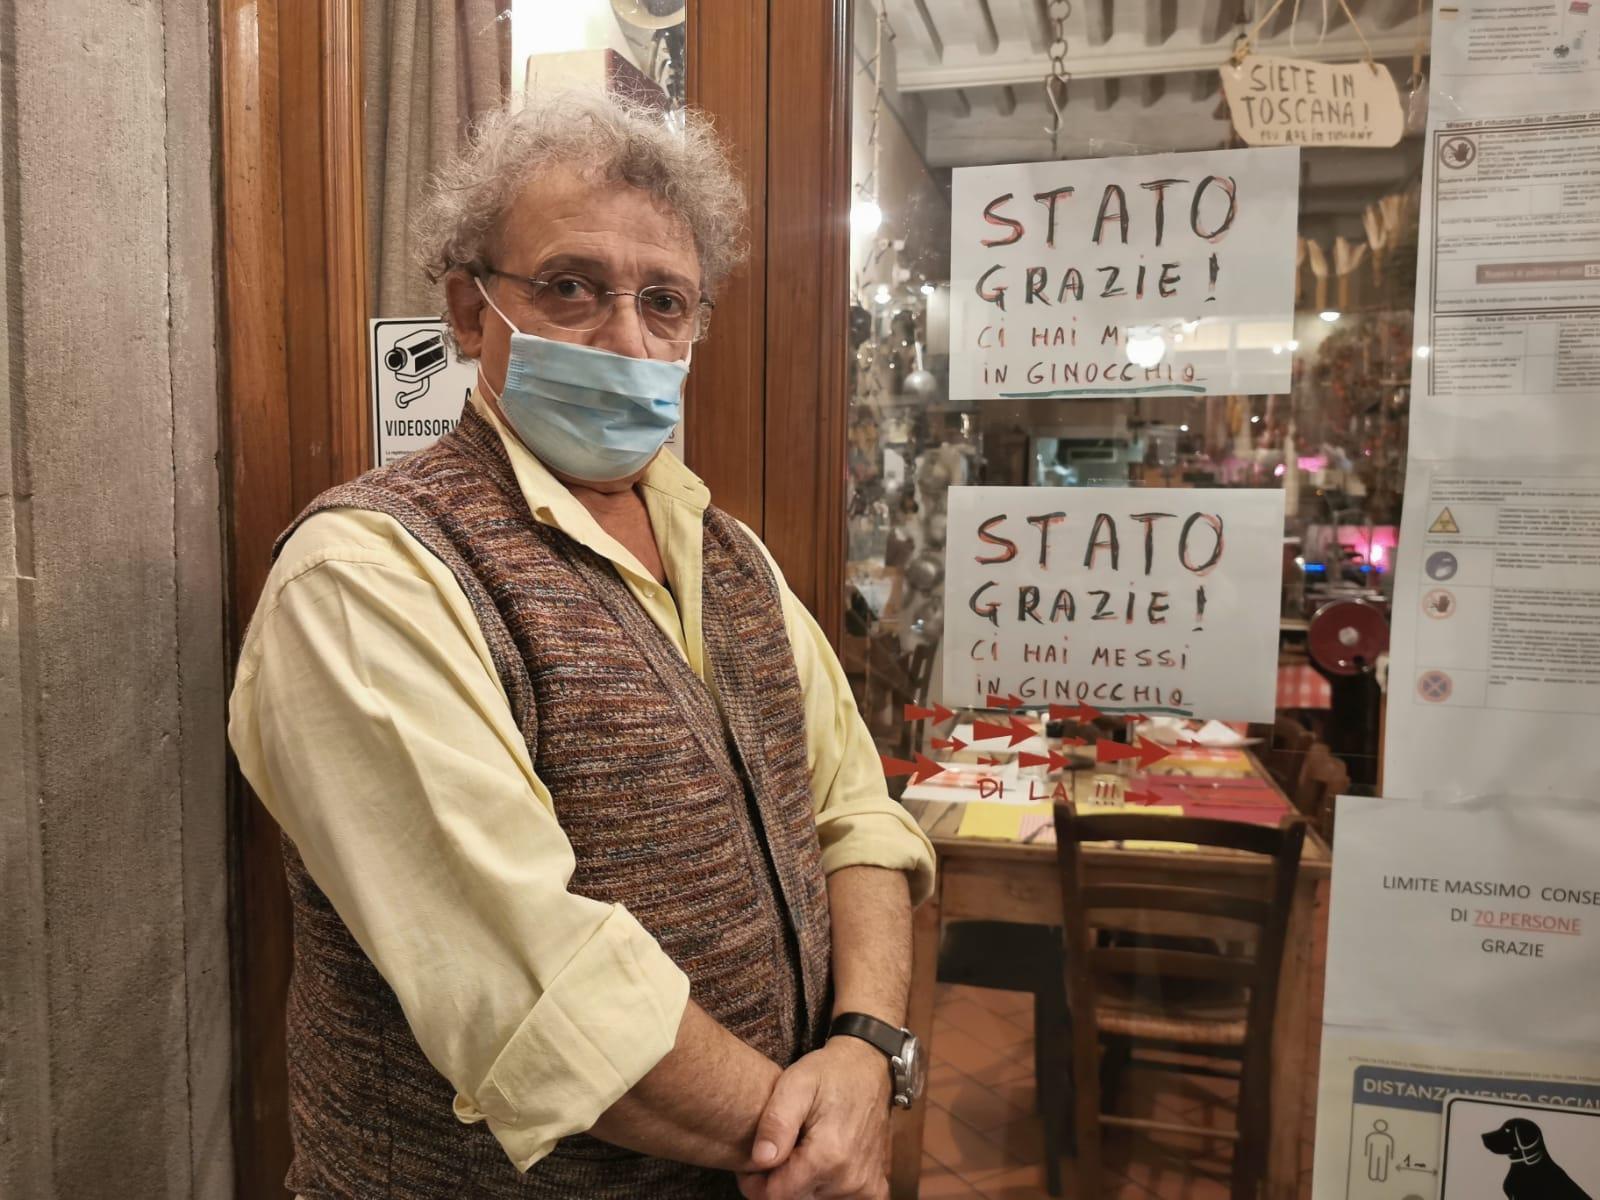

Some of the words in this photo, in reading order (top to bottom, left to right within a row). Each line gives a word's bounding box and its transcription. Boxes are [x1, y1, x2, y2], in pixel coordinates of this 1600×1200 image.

[1250, 60, 1317, 94] SIETE
[1332, 73, 1355, 97] IN
[980, 174, 1238, 249] STATO
[1026, 361, 1198, 386] GINOCCHIO
[974, 510, 1224, 577] STATO
[1019, 676, 1184, 706] GINOCCHIO
[977, 778, 1003, 799] DI
[1383, 875, 1440, 894] LIMITE
[1444, 880, 1531, 899] MASSIMO
[1451, 908, 1468, 923] DI
[1474, 910, 1495, 925] 70
[1500, 911, 1582, 933] PERSONE
[1481, 939, 1545, 958] GRAZIE
